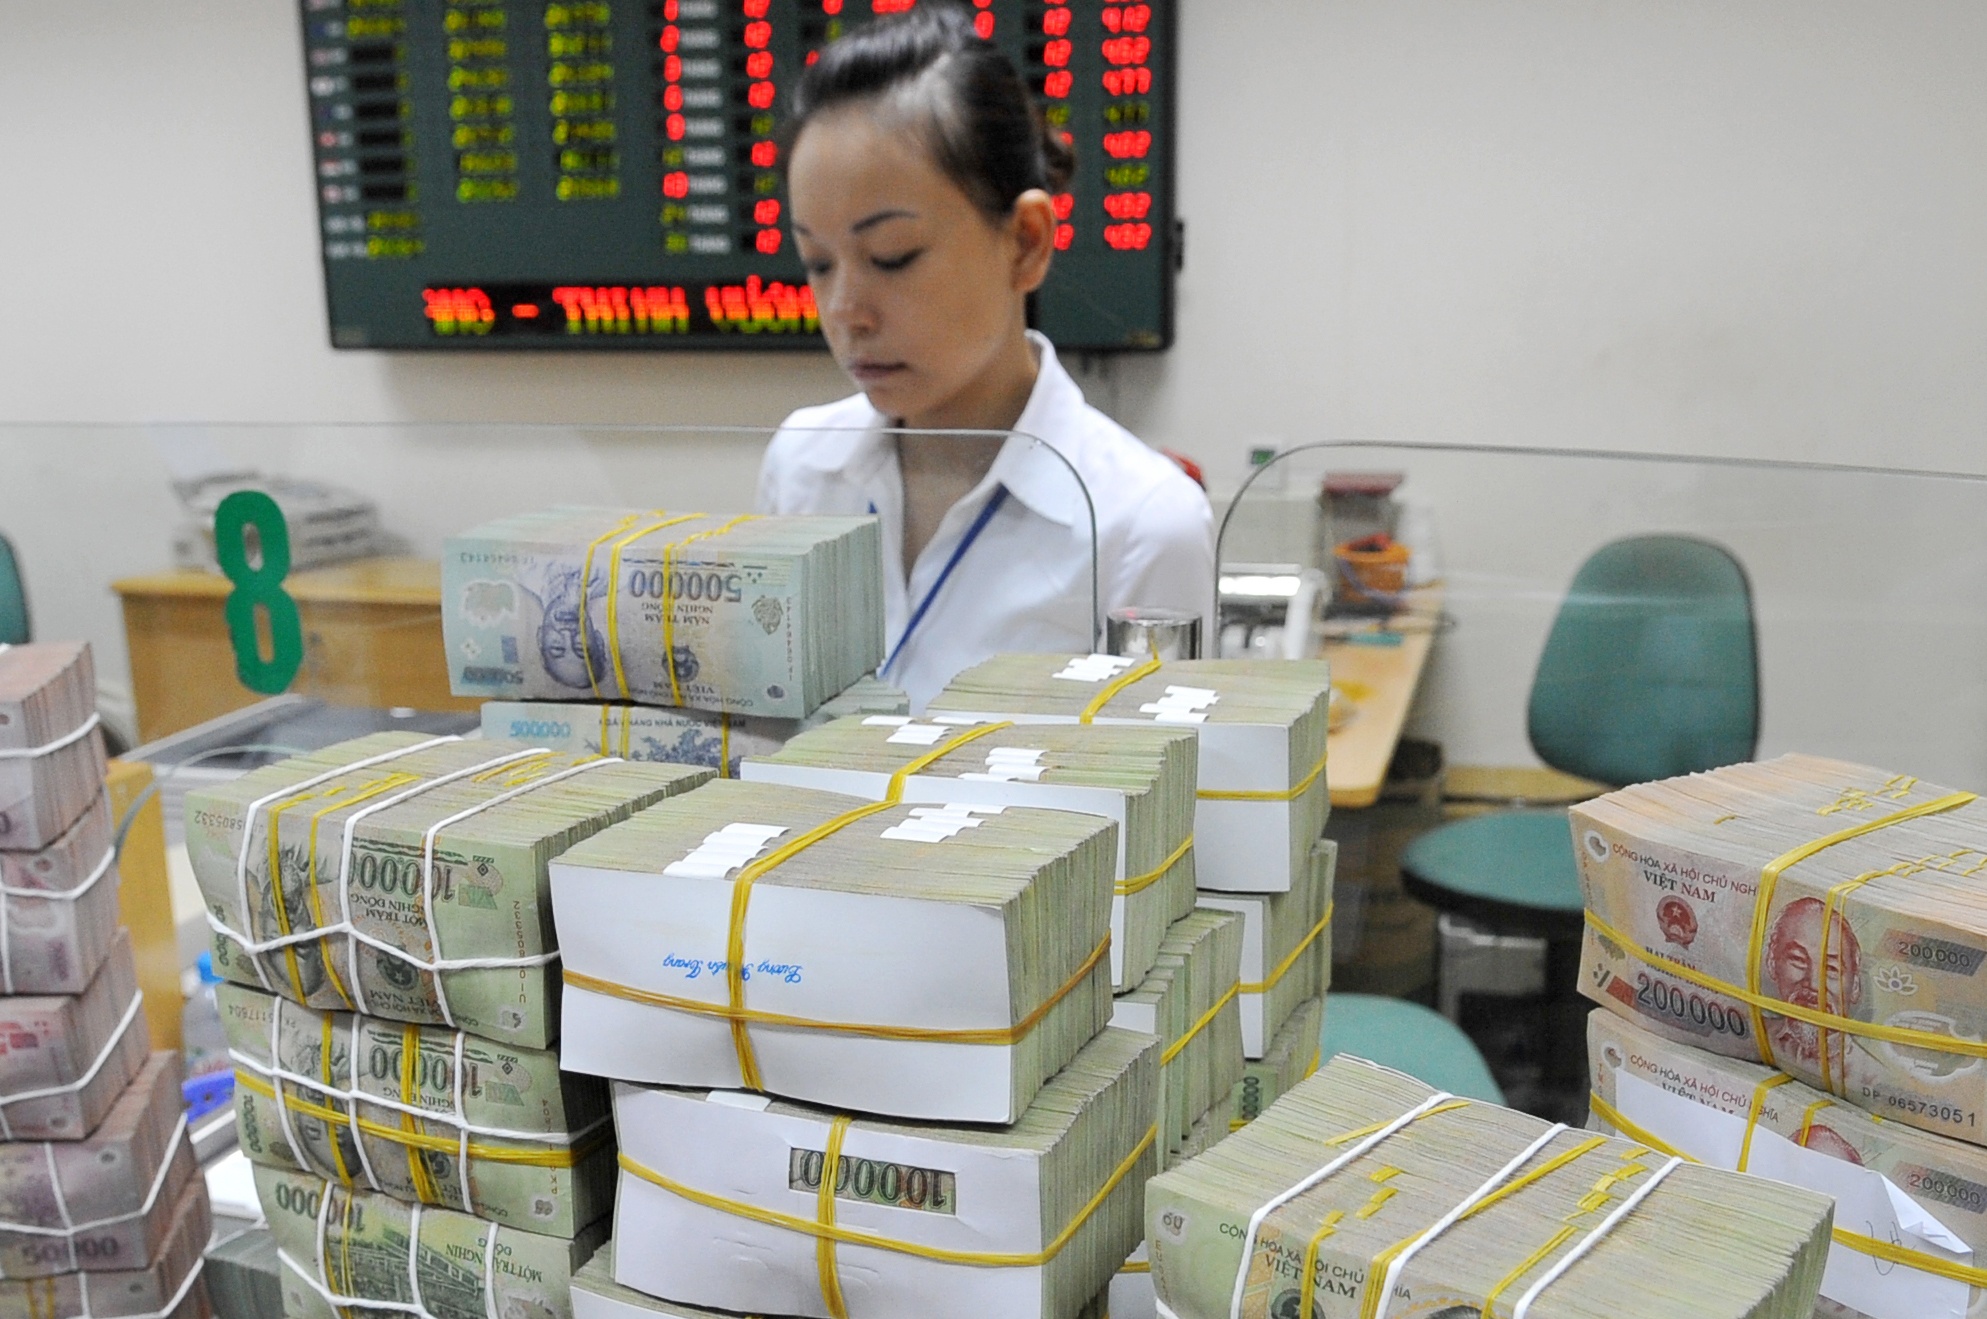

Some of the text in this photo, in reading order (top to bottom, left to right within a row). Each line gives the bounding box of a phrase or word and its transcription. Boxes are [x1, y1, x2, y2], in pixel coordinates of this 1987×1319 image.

[214, 490, 304, 697] 8
[194, 810, 245, 831] 5805332
[1612, 842, 1639, 862] CỘNG
[1702, 873, 1728, 890] CHỦ
[1643, 869, 1716, 903] VIỆT NAM
[388, 900, 424, 913] GHÌN
[1630, 1054, 1658, 1074] CỘNG
[1721, 1090, 1747, 1108] CHỦ
[1861, 1086, 1976, 1128] DP 06573051
[477, 1237, 513, 1258] ĐỒG
[485, 1253, 517, 1279] TRĂ
[1265, 1253, 1304, 1281] VIỆT
